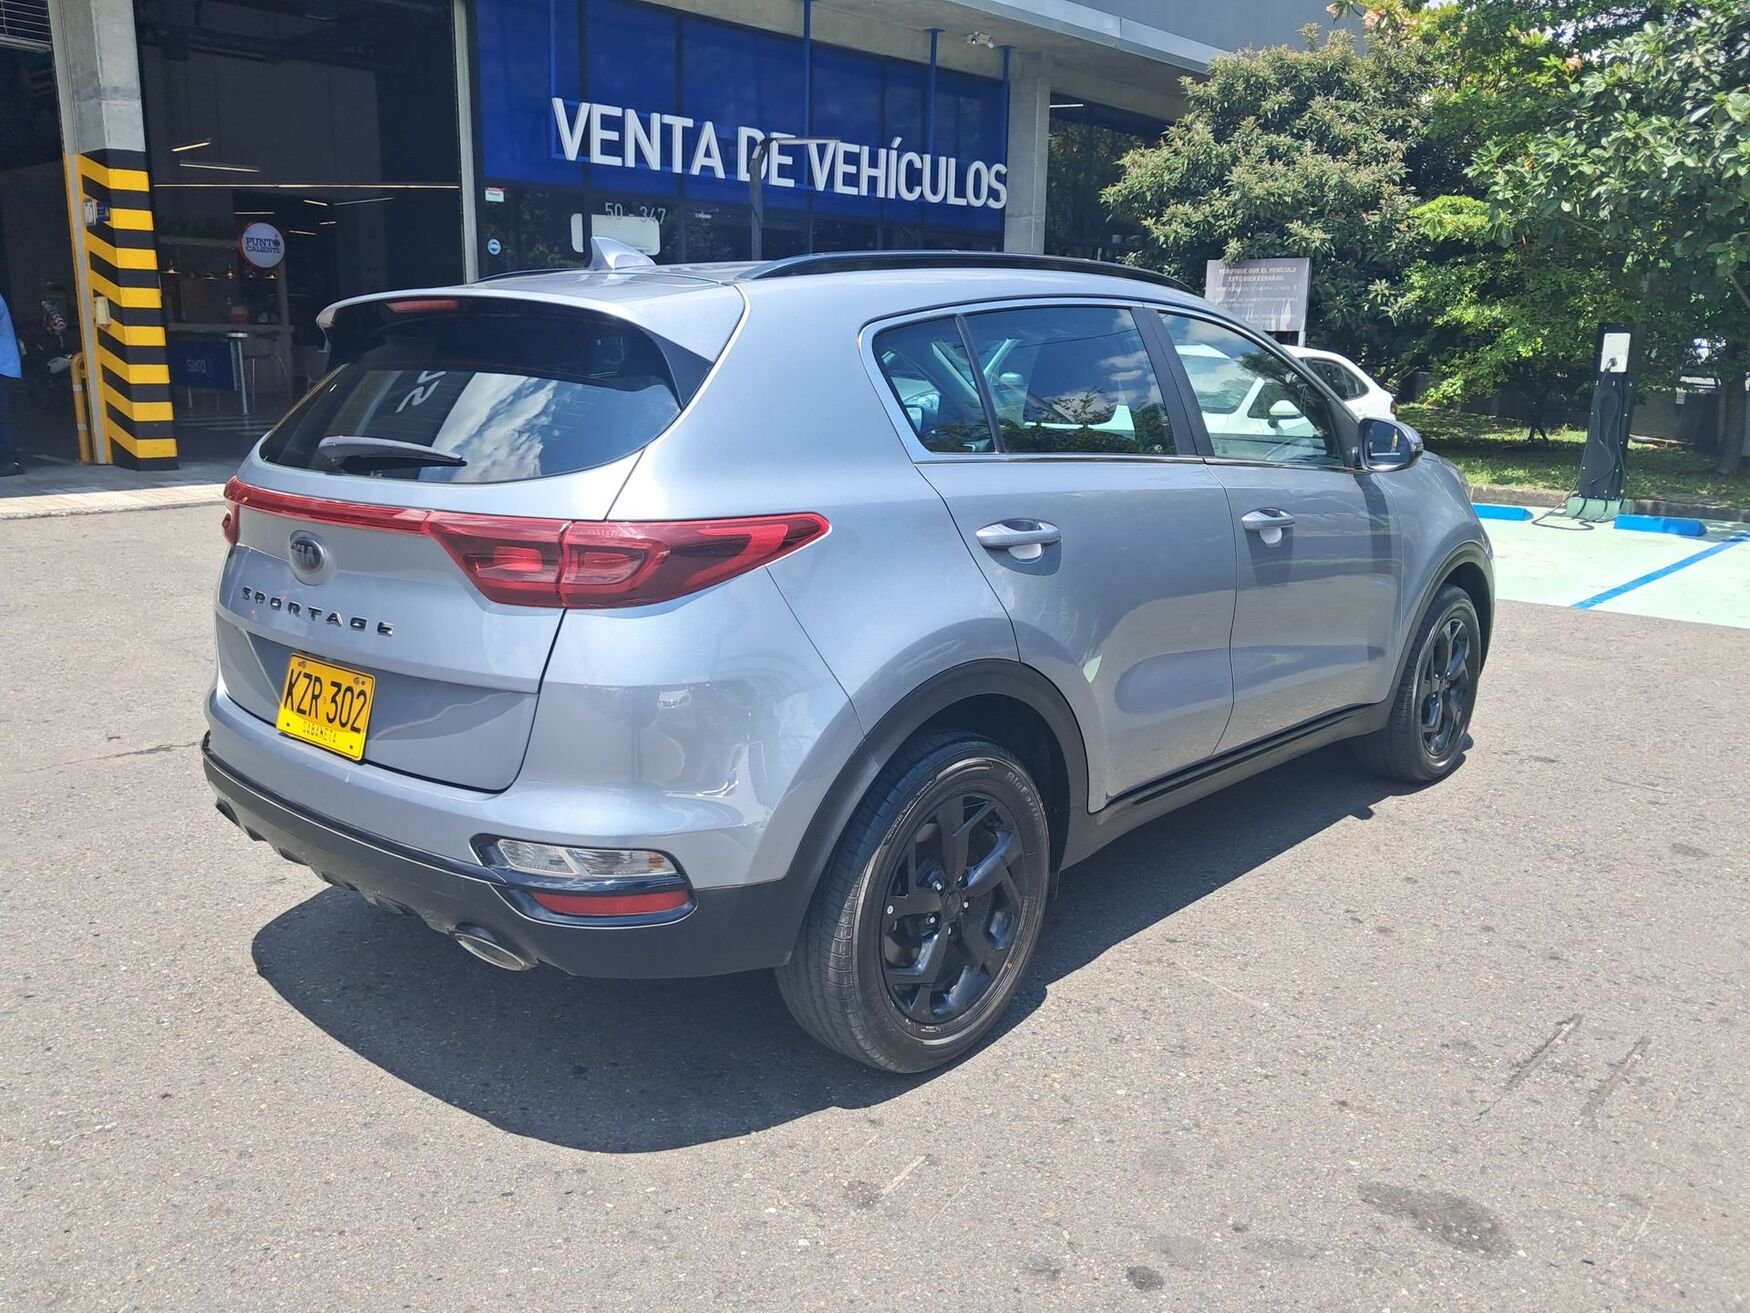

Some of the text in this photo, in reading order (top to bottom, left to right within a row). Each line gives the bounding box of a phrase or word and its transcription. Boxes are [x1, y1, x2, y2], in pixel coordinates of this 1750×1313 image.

[552, 97, 1008, 209] VENTA DE VEHÍCULOS
[605, 202, 624, 220] 50
[640, 206, 666, 224] 347
[242, 586, 394, 637] SPORTAGE
[284, 668, 367, 734] KZR 302
